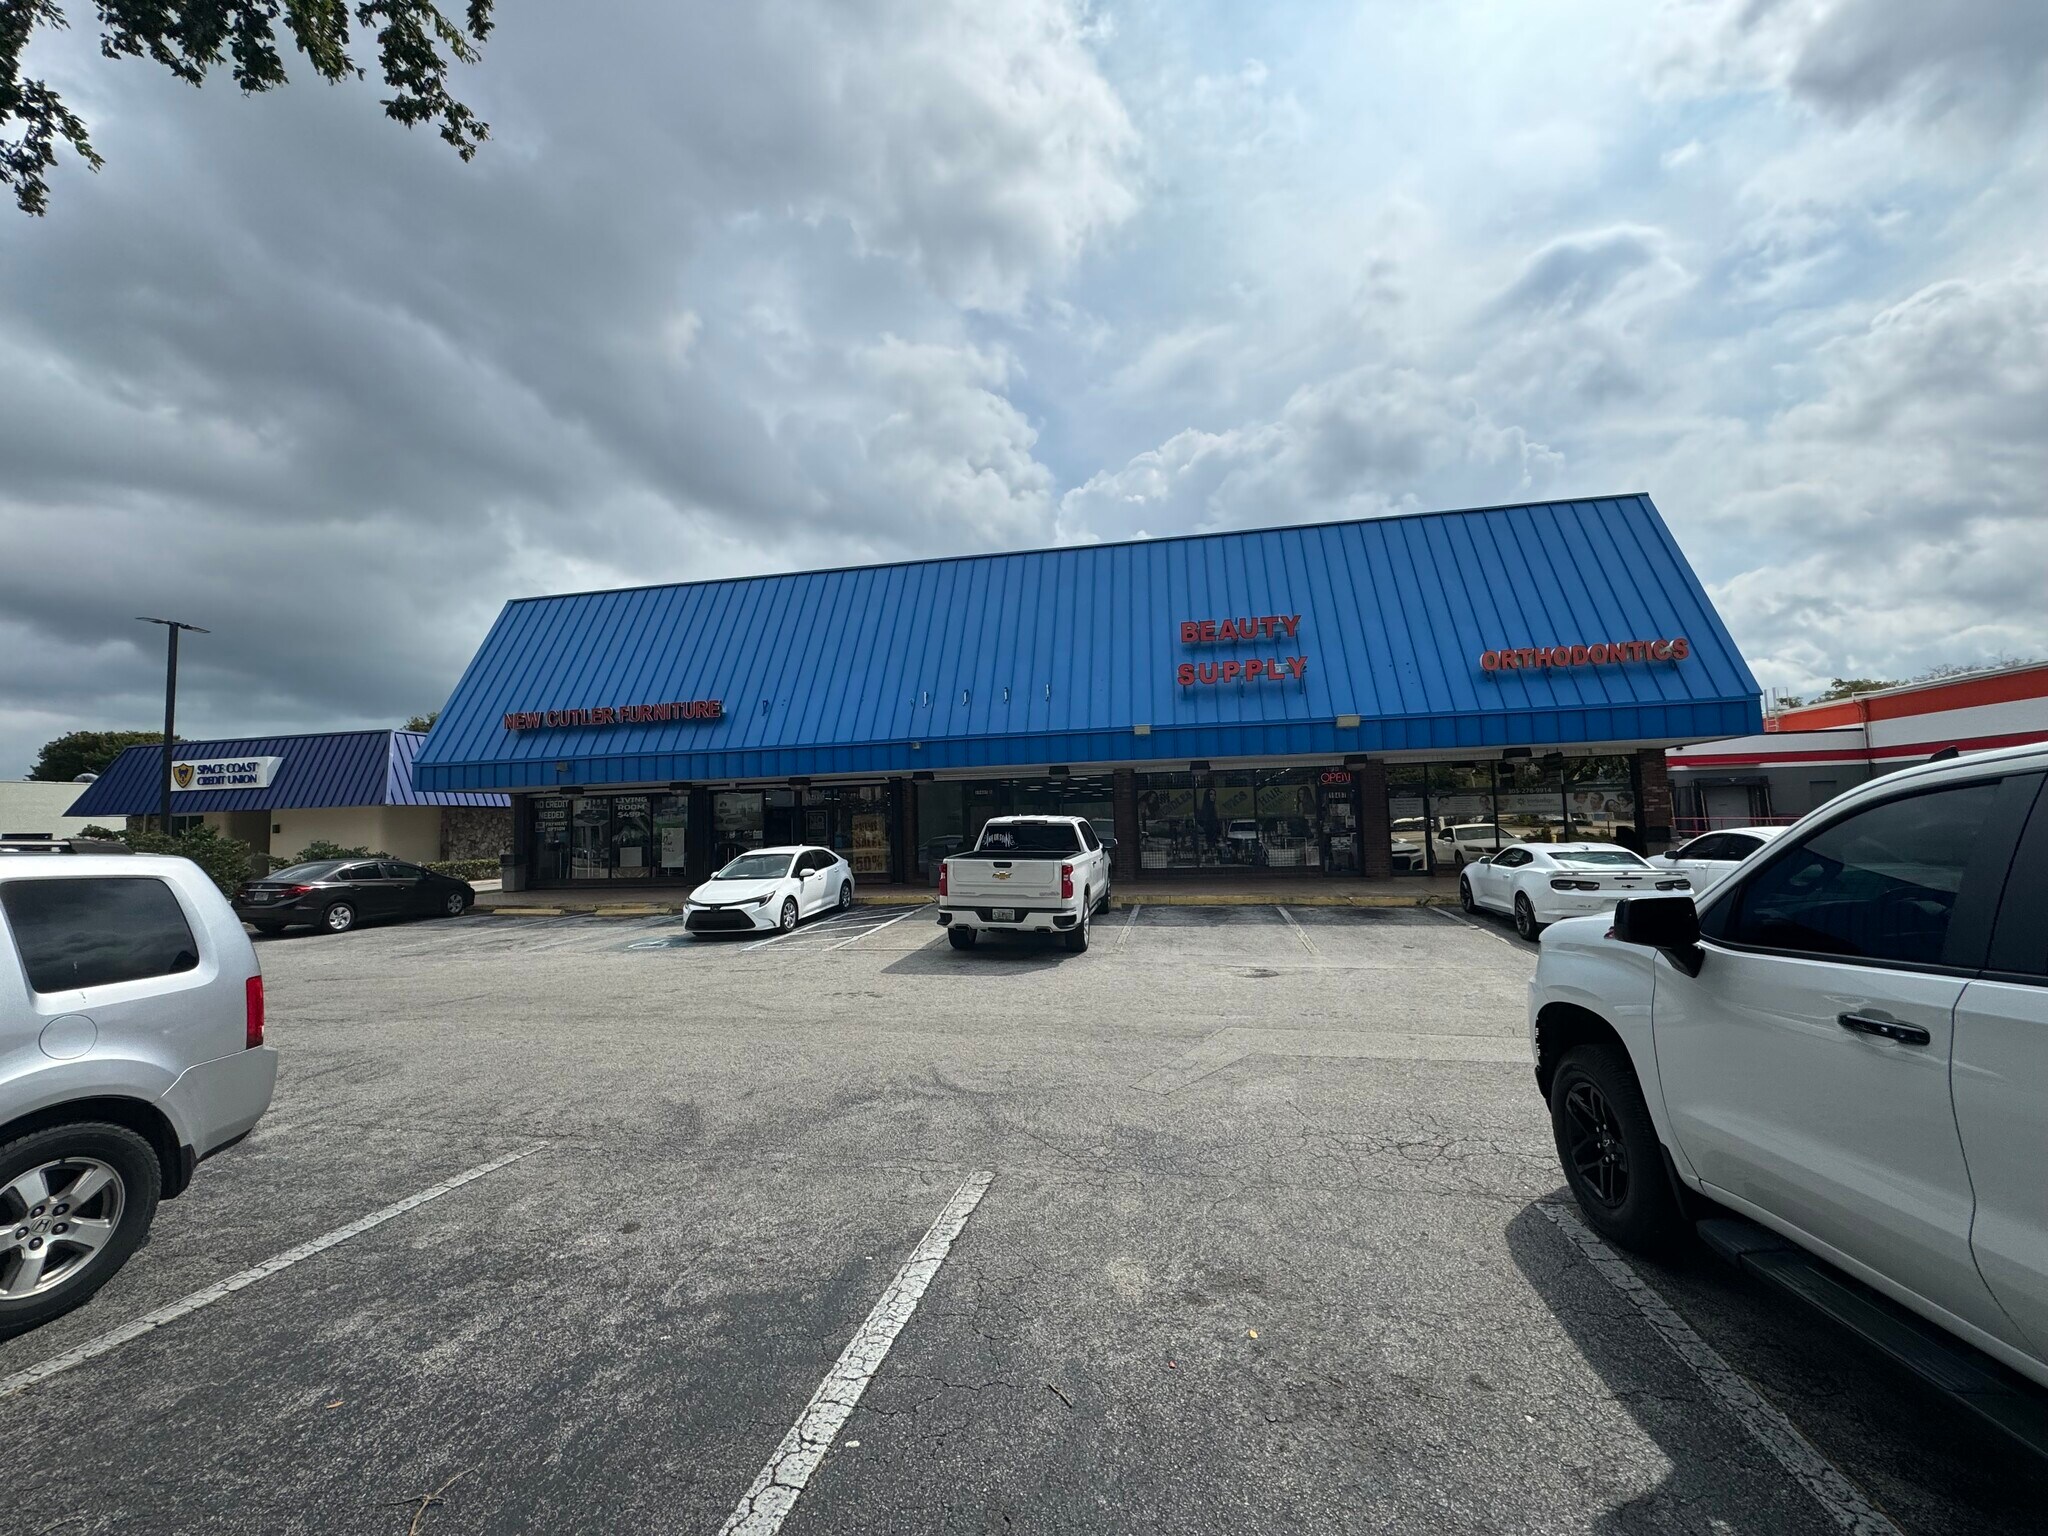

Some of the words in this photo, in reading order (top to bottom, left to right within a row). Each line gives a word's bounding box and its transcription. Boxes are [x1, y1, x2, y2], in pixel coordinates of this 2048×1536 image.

[1181, 615, 1301, 643] BEAUTY
[1480, 637, 1690, 671] ORTHODONTICS
[1178, 656, 1308, 686] SUPPLY
[504, 712, 544, 730] NEW
[546, 706, 615, 728] CUTLER
[618, 699, 723, 724] FURNITURE
[197, 764, 224, 775] SPACE
[226, 762, 259, 773] COAST
[197, 775, 227, 786] CREDIT
[227, 774, 258, 785] UNION
[1320, 772, 1351, 783] OPEN
[534, 800, 544, 809] NO
[545, 799, 569, 809] CREDIT
[615, 796, 647, 804] LIVING
[1258, 787, 1283, 806] HAIR
[538, 810, 565, 820] NEEDED
[855, 855, 883, 872] 50%
